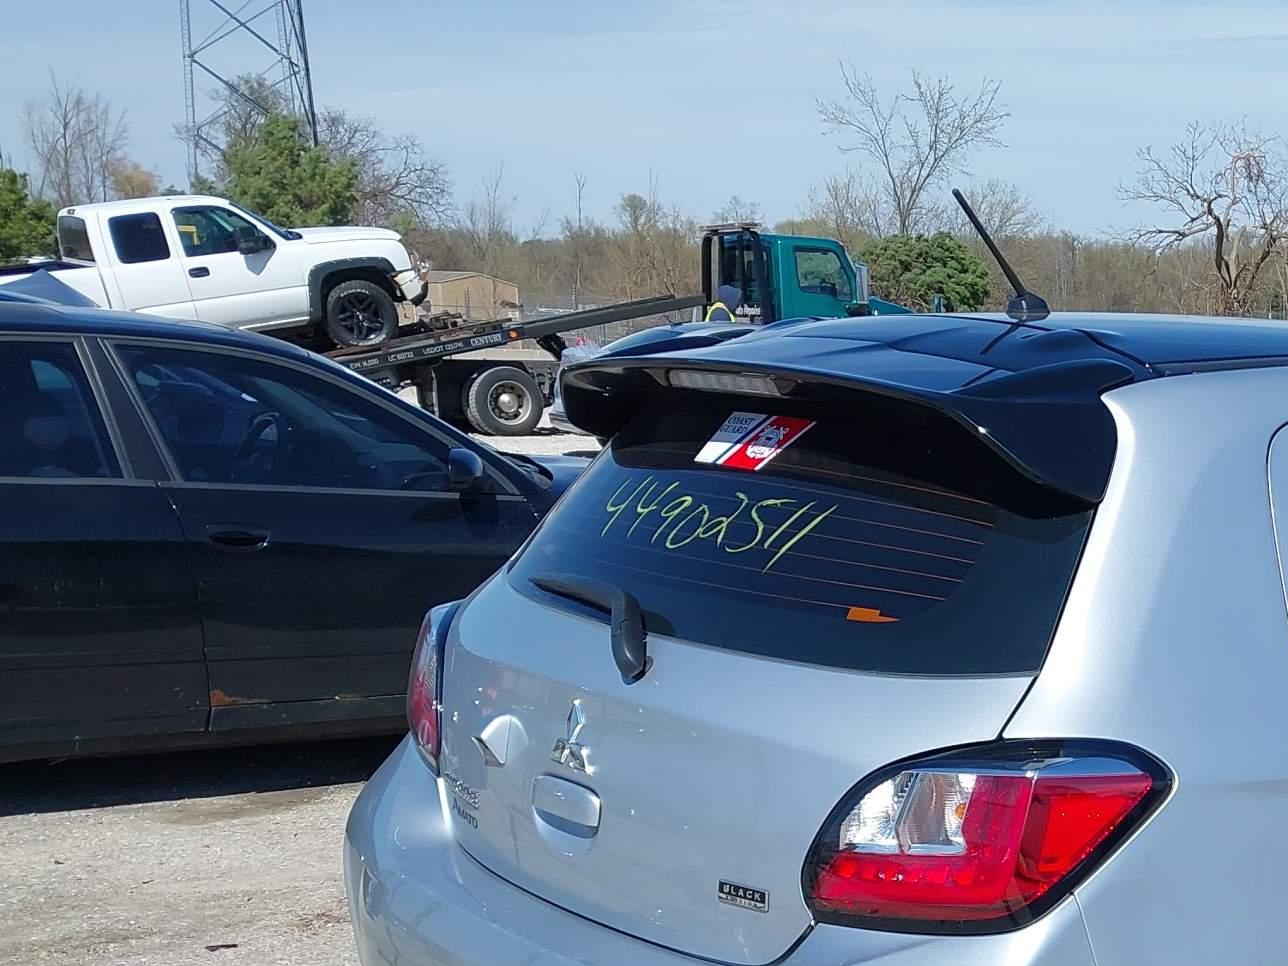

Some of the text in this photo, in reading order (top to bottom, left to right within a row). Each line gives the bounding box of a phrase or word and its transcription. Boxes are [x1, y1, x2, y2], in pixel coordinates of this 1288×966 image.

[470, 333, 502, 347] CENTURY
[422, 345, 444, 355] USDOT
[727, 416, 757, 425] COAST
[720, 424, 749, 434] GUARD
[601, 476, 839, 574] 44902511
[723, 884, 761, 901] BLACK
